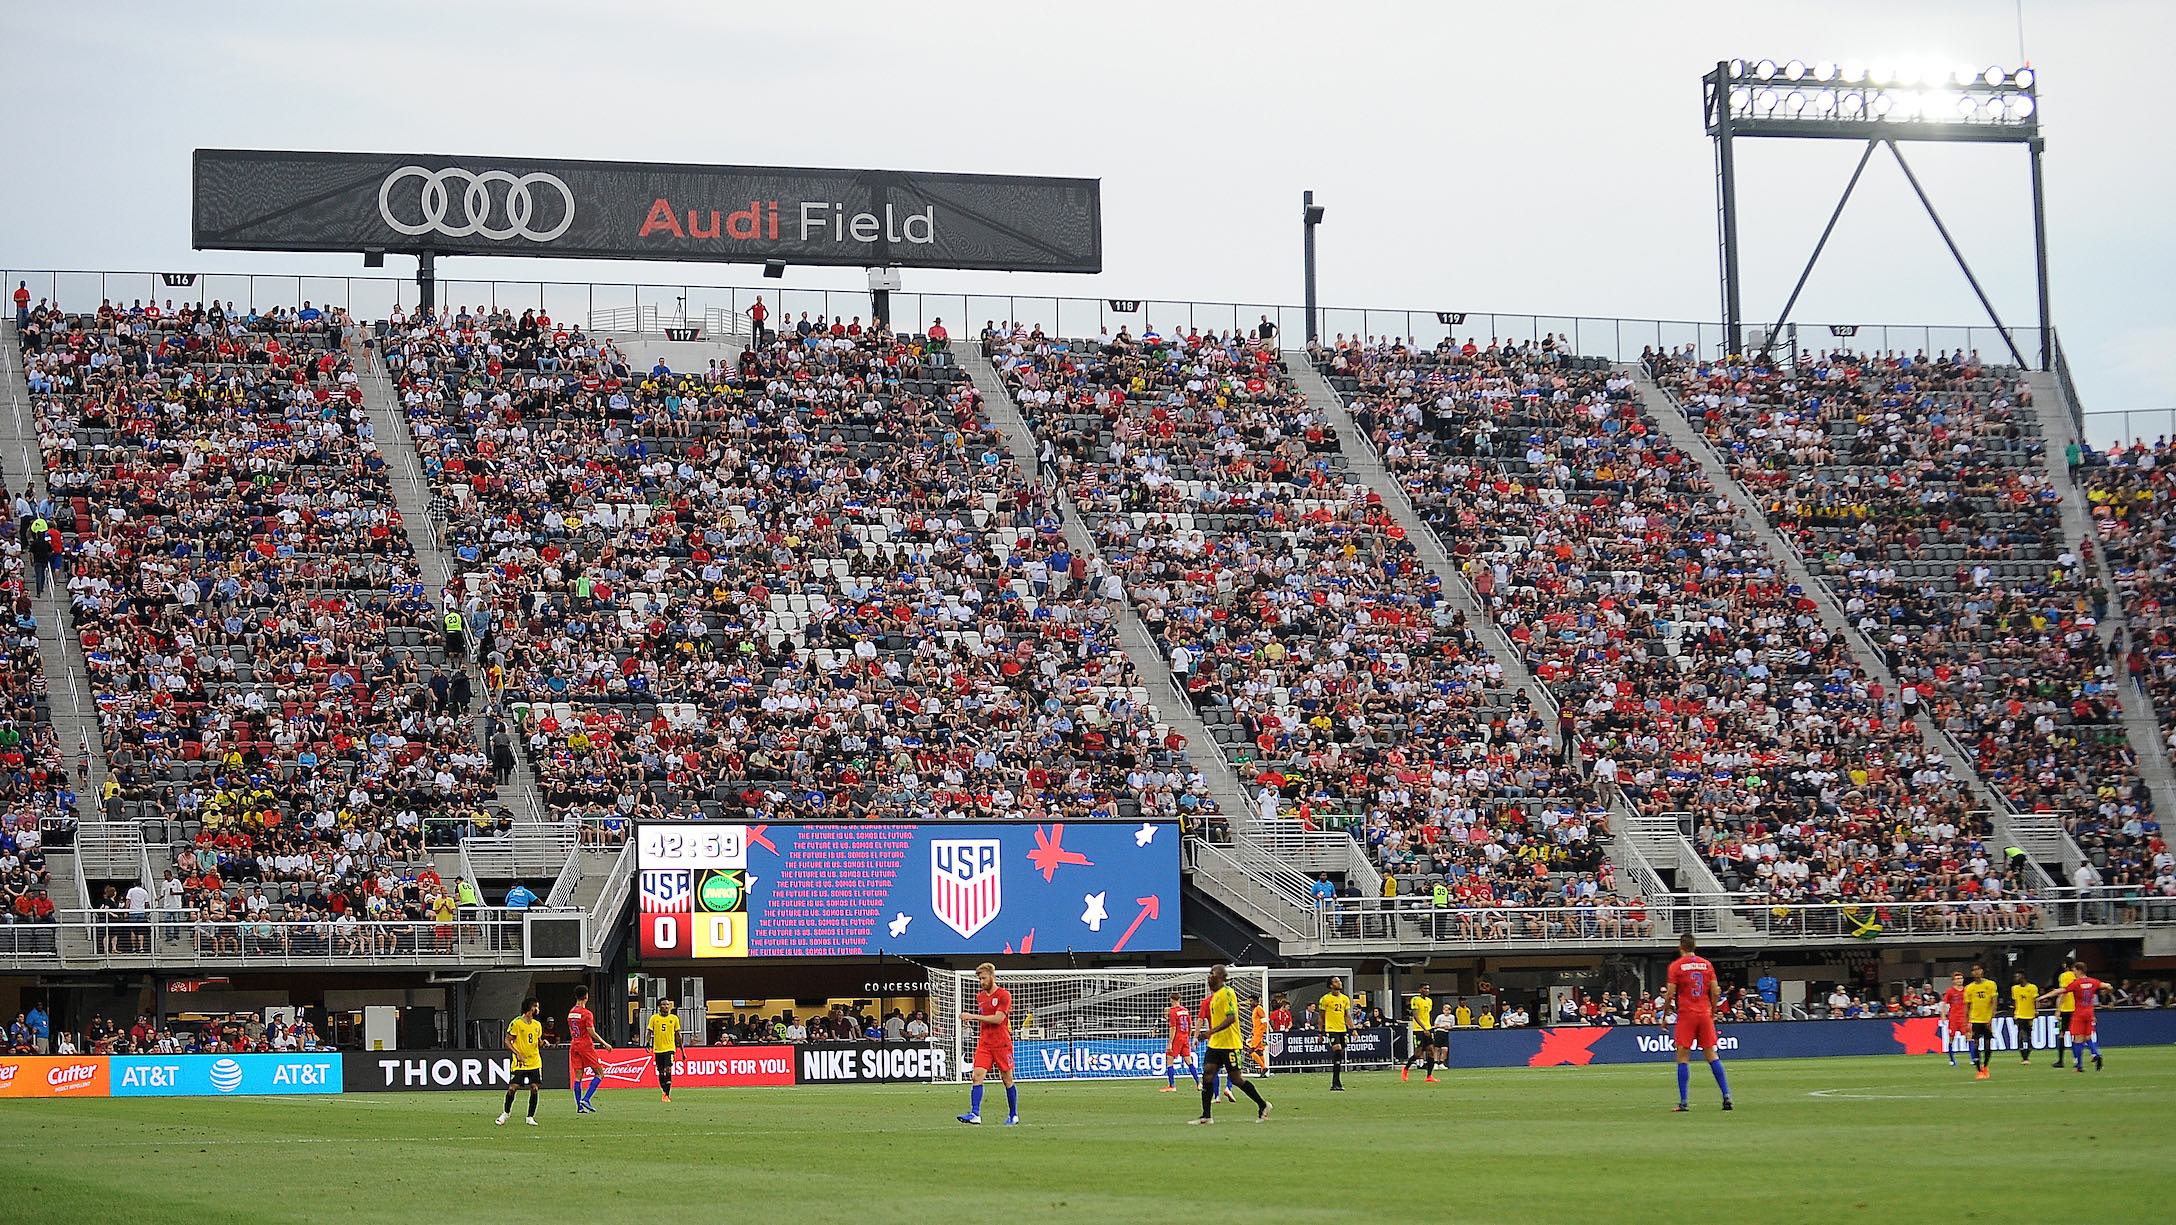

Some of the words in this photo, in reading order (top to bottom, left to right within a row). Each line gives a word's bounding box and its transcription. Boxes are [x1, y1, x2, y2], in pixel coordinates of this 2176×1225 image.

[638, 199, 780, 241] Audi
[800, 202, 935, 244] Field
[170, 274, 188, 285] 116
[1116, 300, 1134, 312] 118
[1442, 314, 1460, 323] 119
[672, 330, 692, 340] 117
[1834, 326, 1852, 336] 120
[646, 832, 739, 858] 42:59
[937, 846, 994, 880] USA
[643, 873, 690, 901] USA
[654, 916, 677, 948] 0
[709, 916, 732, 948] 0
[528, 1033, 534, 1044] 8
[1288, 1036, 1303, 1044] ONE
[1229, 1052, 1236, 1062] 6
[1288, 1044, 1303, 1053] ONE
[1304, 1044, 1328, 1052] TEAM.
[653, 1062, 684, 1076] TIS
[730, 1060, 756, 1074] FOR
[758, 1059, 790, 1074] YOU.
[804, 1050, 858, 1080] NIKE
[862, 1049, 946, 1078] SOCCER
[47, 1064, 98, 1085] Cutter
[122, 1066, 180, 1087] AT&T
[272, 1064, 330, 1085] AT&T
